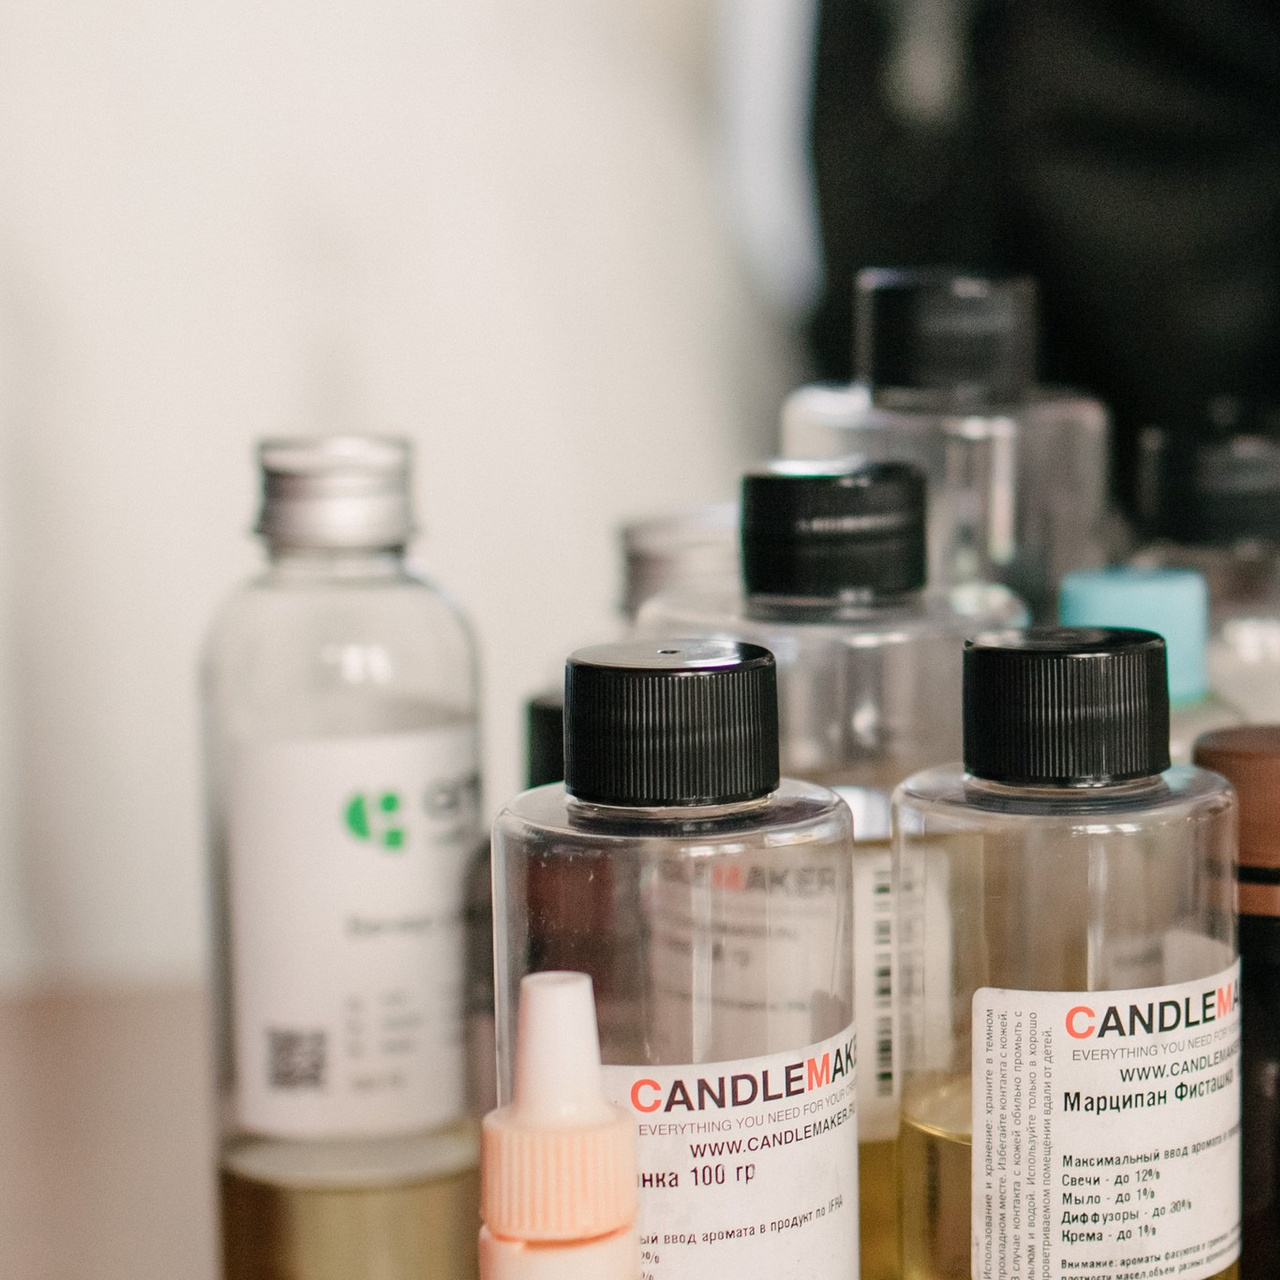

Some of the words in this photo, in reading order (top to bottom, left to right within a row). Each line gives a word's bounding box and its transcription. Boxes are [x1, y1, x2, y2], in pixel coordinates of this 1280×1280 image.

[986, 1008, 994, 1053] темном
[997, 1010, 1008, 1050] кожей.
[1014, 1021, 1024, 1073] промыть
[1029, 1011, 1039, 1056] хорошо
[1041, 1026, 1054, 1064] детей.
[1072, 1045, 1158, 1061] EVERYTHING
[1161, 1041, 1185, 1053] YOU
[1187, 1034, 1212, 1049] NEED
[999, 1061, 1007, 1111] контакта
[1028, 1072, 1037, 1111] только
[1044, 1066, 1052, 1079] от
[986, 1069, 994, 1115] храните
[1011, 1076, 1022, 1126] обильно
[1043, 1080, 1053, 1116] вдали
[1063, 1090, 1167, 1115] Марципан
[639, 1119, 732, 1136] EVERYTHING
[735, 1115, 764, 1130] YOU
[768, 1107, 801, 1125] NEED
[803, 1101, 824, 1118] FOR
[825, 1091, 847, 1111] YOUR
[985, 1119, 994, 1177] хранение:
[997, 1113, 1008, 1171] Избегайте
[1011, 1130, 1021, 1166] кожей
[1026, 1114, 1038, 1186] Используйте
[1042, 1118, 1053, 1186] помещении
[1062, 1149, 1160, 1168] Максимальный
[1164, 1146, 1189, 1160] ввод
[637, 1171, 680, 1188] нка
[690, 1163, 726, 1187] 100
[736, 1163, 756, 1185] гр
[999, 1174, 1007, 1211] месте.
[1062, 1174, 1101, 1187] Свечи
[1114, 1174, 1130, 1186] до
[1136, 1168, 1161, 1182] 12%
[1012, 1180, 1021, 1230] контакта
[1026, 1190, 1037, 1228] водой.
[1061, 1210, 1139, 1225] Диффузоры
[1152, 1206, 1166, 1218] до
[1062, 1193, 1101, 1205] Мыло
[1115, 1193, 1131, 1205] до
[1137, 1188, 1155, 1201] 1%
[664, 1231, 697, 1245] ввод
[702, 1225, 756, 1245] аромата
[760, 1223, 767, 1235] в
[770, 1210, 813, 1233] продукт
[816, 1206, 826, 1219] по
[983, 1194, 993, 1280] Использование
[1061, 1230, 1103, 1245] Крема
[1116, 1230, 1132, 1242] до
[1138, 1224, 1156, 1238] 1%
[1012, 1234, 1022, 1272] случае
[1061, 1259, 1118, 1270] Внимание:
[1119, 1254, 1162, 1269] ароматы
